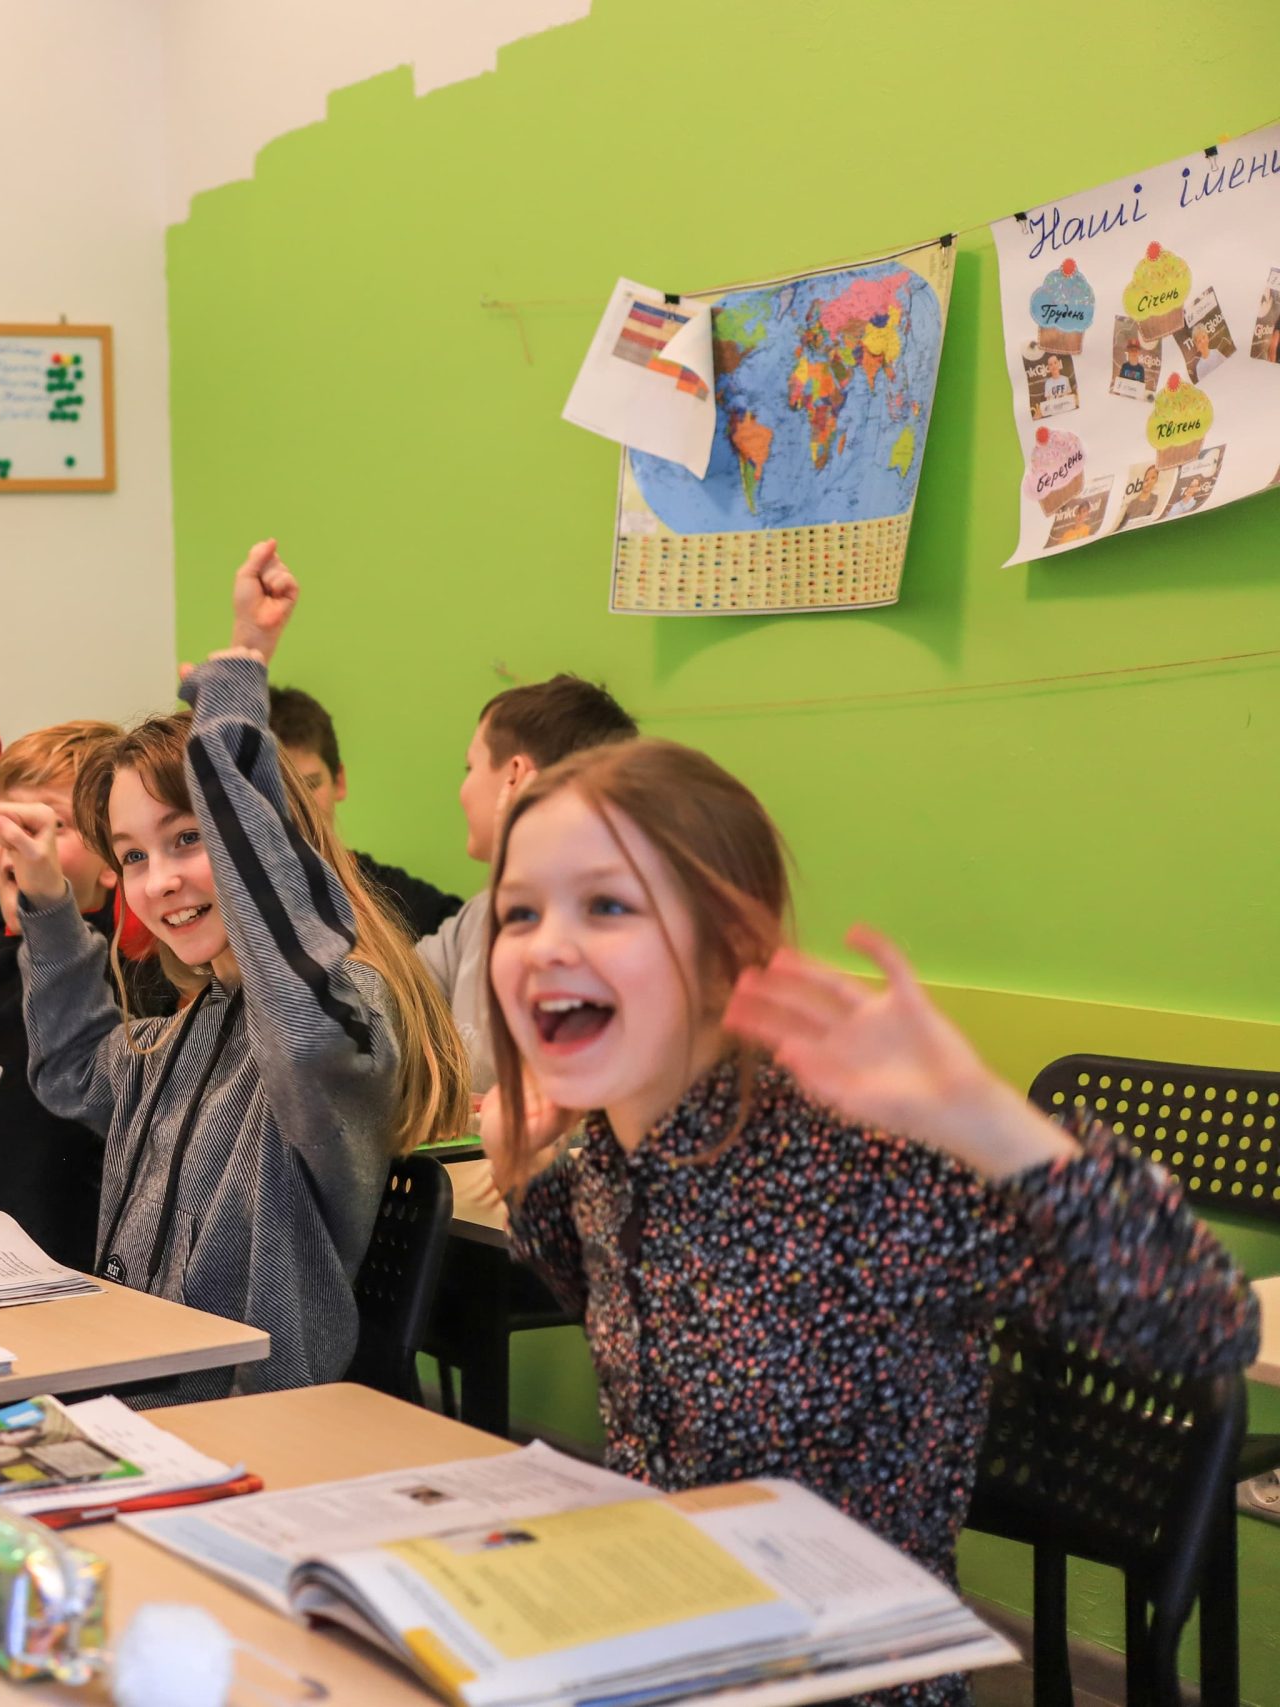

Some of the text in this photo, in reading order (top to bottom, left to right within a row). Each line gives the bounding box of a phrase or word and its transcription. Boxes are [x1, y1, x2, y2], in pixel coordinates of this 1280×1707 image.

[1028, 183, 1147, 260] Наші
[1137, 288, 1179, 312] Січень
[1041, 304, 1084, 324] Грудень
[1156, 419, 1201, 440] Квітень
[1036, 450, 1083, 493] березень
